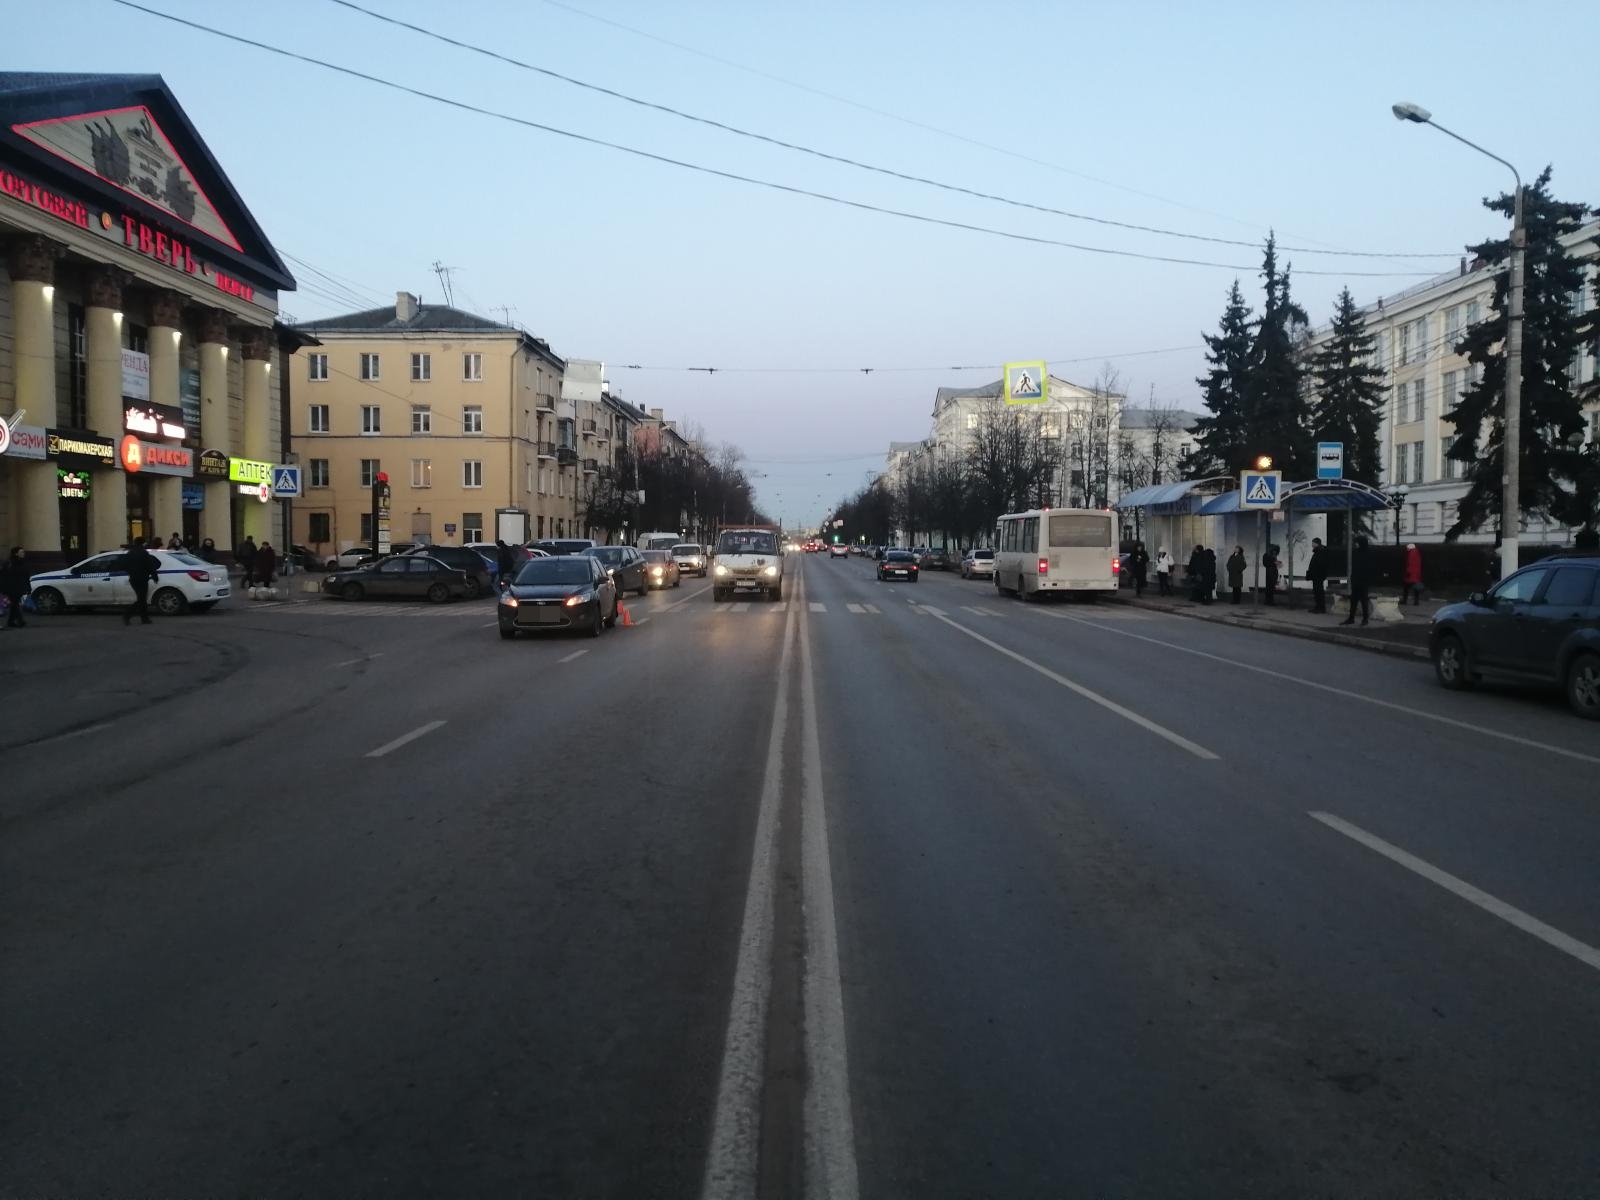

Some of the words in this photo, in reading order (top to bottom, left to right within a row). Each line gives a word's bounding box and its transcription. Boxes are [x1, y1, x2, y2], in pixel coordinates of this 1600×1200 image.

[121, 214, 197, 274] ТВЕРЬ
[121, 353, 148, 373] ЕНДА
[59, 438, 113, 458] ПАРИКМАХЕРСКАЯ
[147, 447, 190, 467] ДИКСИ
[238, 461, 272, 480] АПТЕК
[61, 487, 84, 498] ЦВЕТЫ
